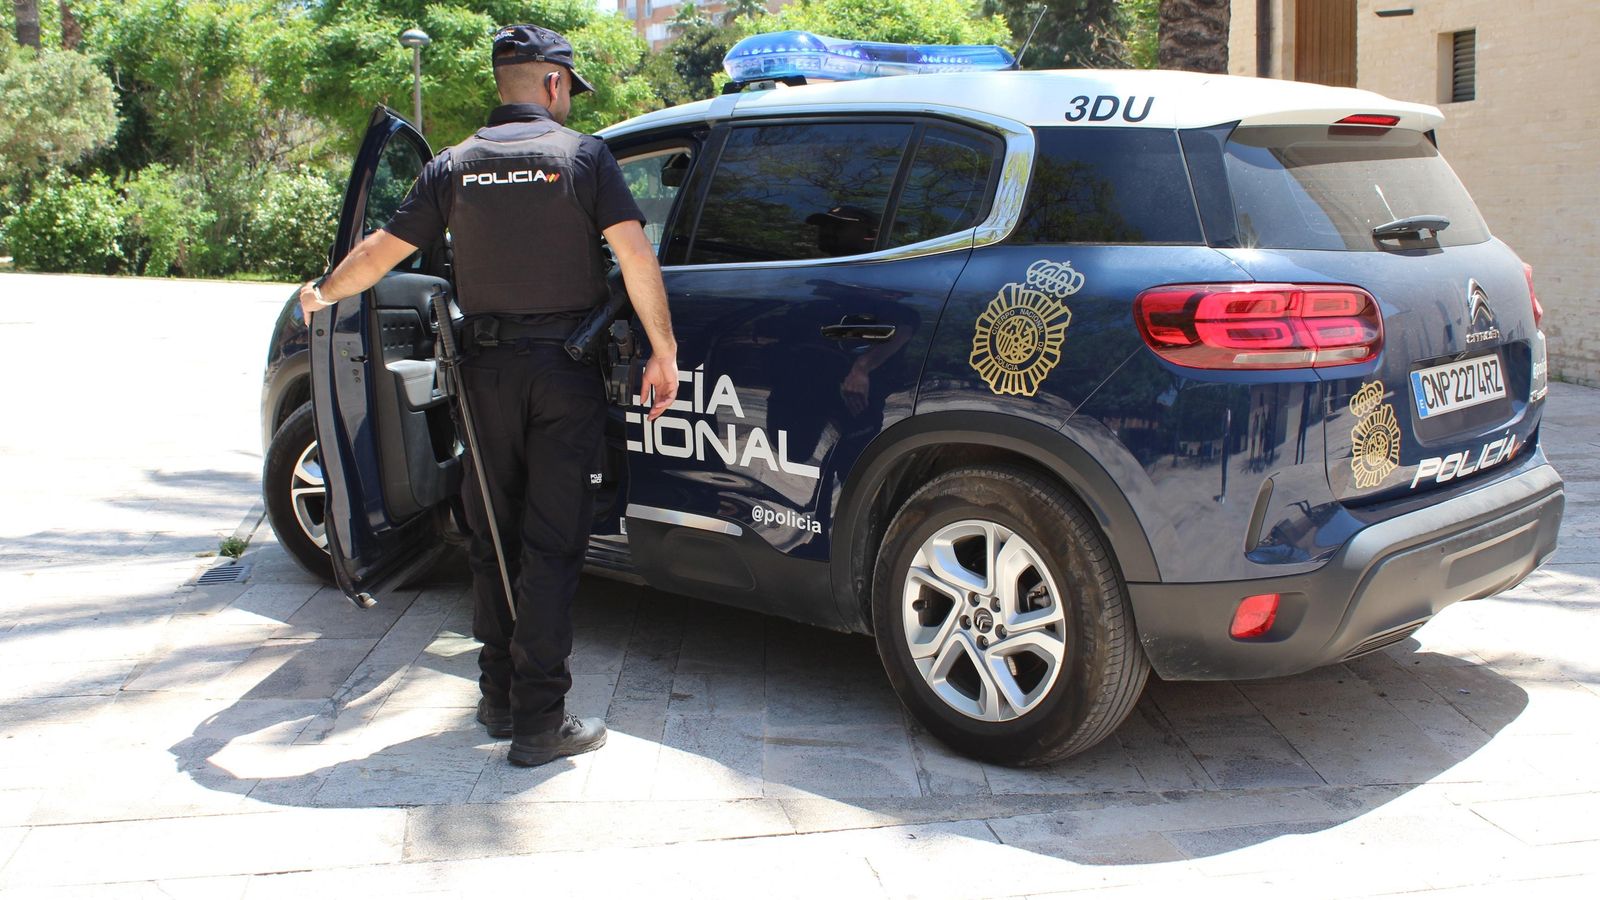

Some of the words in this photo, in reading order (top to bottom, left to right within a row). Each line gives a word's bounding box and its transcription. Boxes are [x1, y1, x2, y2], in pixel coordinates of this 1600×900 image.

[1064, 95, 1155, 122] 3DU
[462, 169, 548, 187] POLICIA
[991, 309, 1016, 335] CUERPO
[1020, 308, 1044, 335] NACIONAL
[1410, 428, 1516, 489] POLICÍA
[751, 505, 822, 535] @policia
